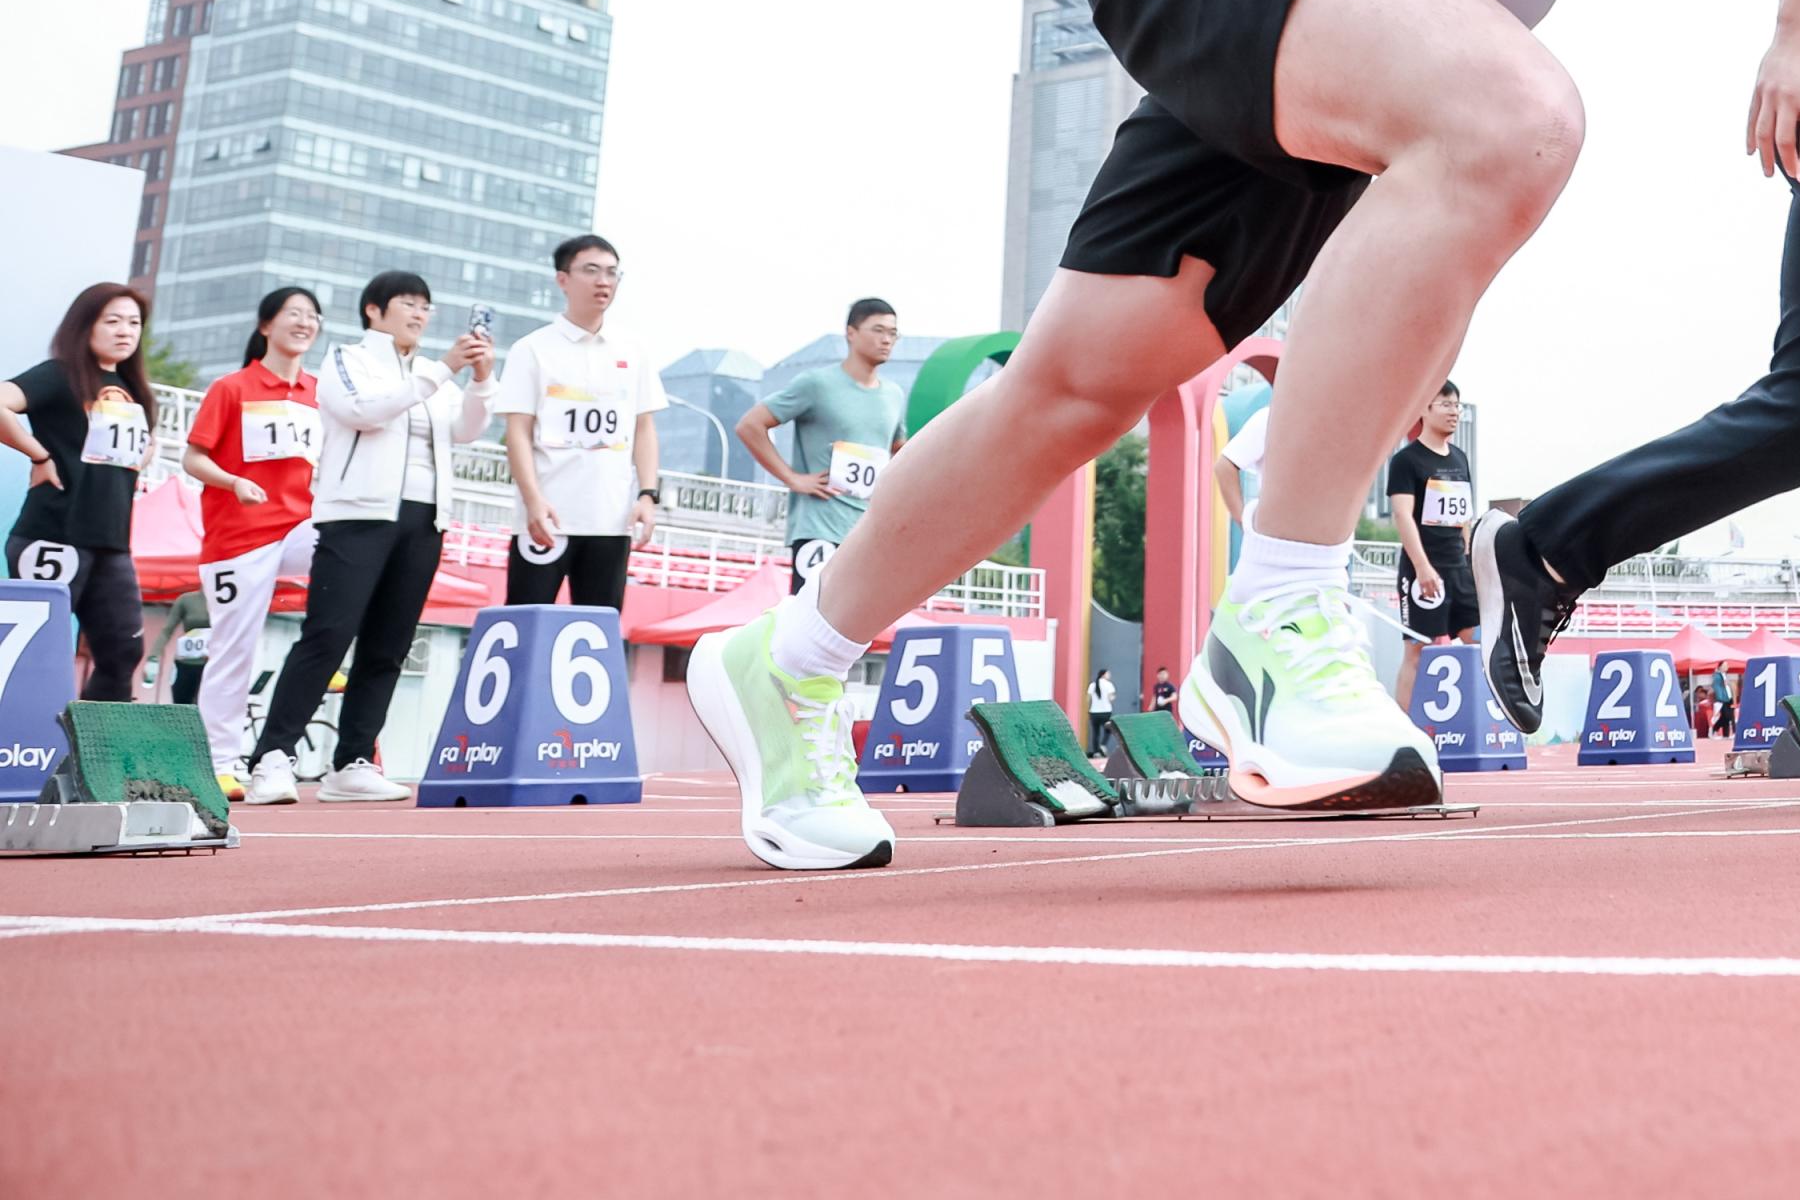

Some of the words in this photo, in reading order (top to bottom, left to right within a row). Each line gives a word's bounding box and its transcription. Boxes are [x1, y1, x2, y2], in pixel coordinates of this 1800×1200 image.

[564, 408, 618, 434] 109
[1437, 497, 1467, 516] 159
[33, 547, 64, 581] 5
[214, 571, 238, 604] 5
[184, 639, 208, 651] 00
[464, 621, 519, 725] 6
[551, 621, 611, 725] 6
[971, 638, 1010, 706] 5
[890, 638, 943, 726] 5
[1423, 655, 1462, 722] 3
[1597, 659, 1633, 720] 2
[1650, 659, 1678, 718] 2
[1754, 663, 1777, 717] 1
